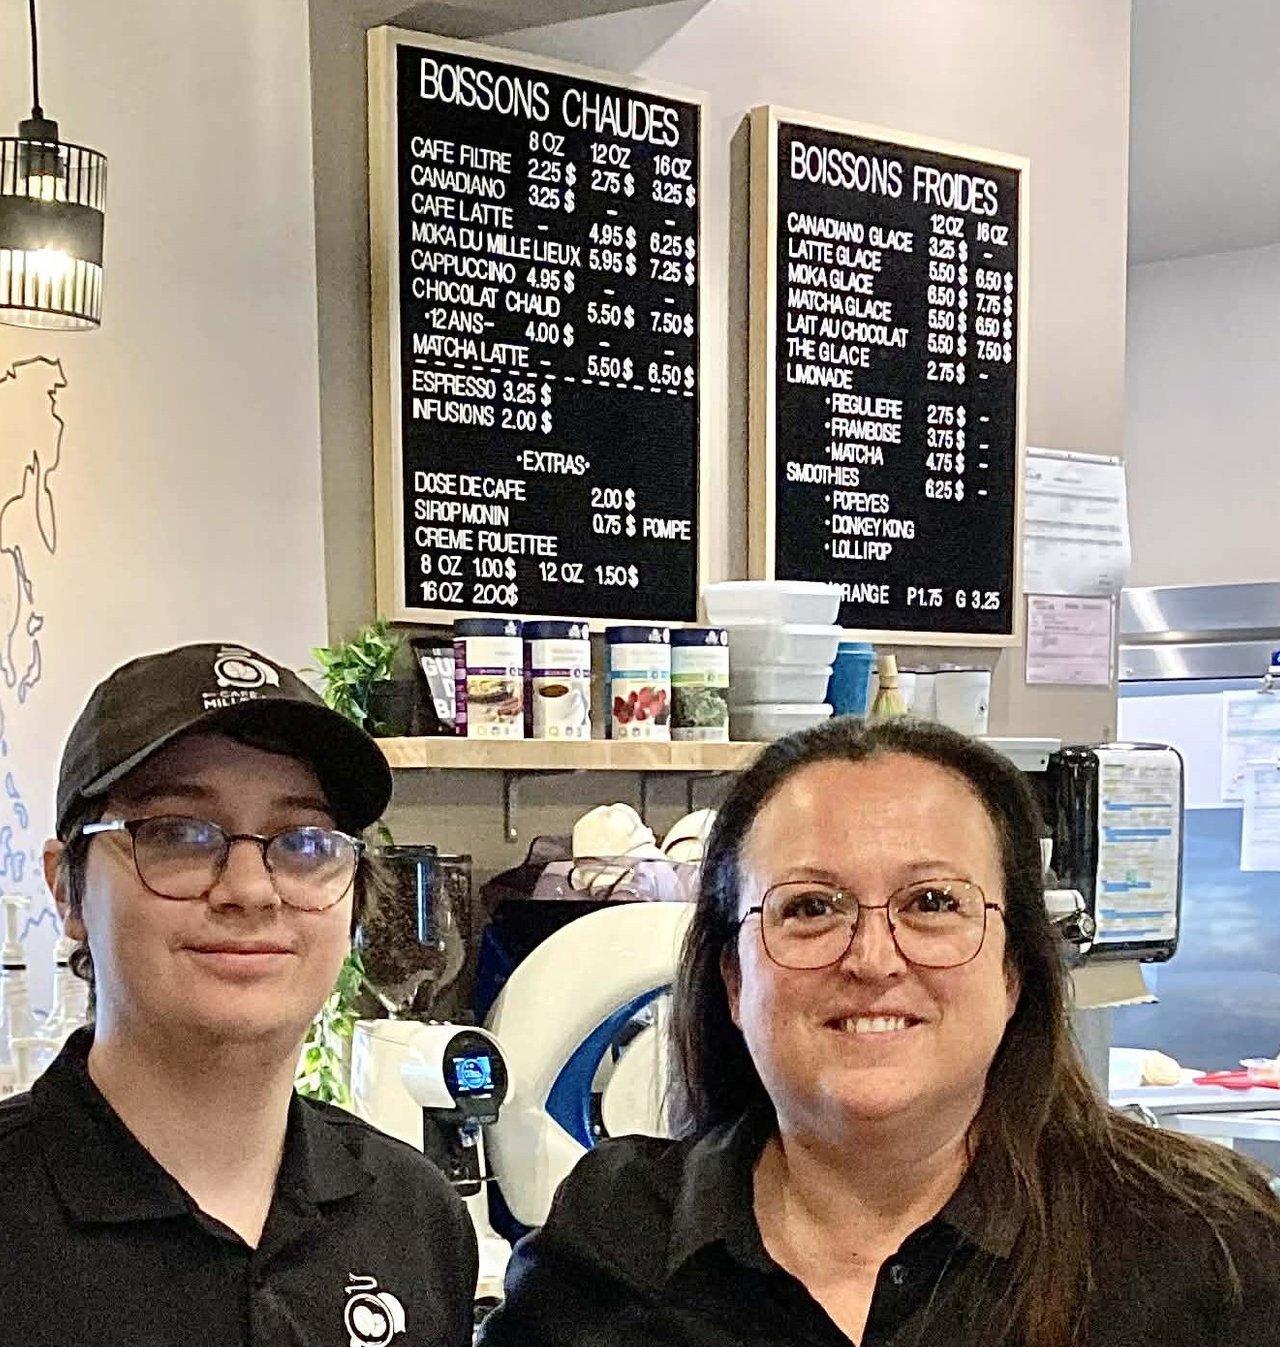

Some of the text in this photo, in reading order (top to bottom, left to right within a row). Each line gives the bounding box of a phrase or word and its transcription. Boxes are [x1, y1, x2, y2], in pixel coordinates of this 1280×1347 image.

[420, 57, 680, 148] BOISSONS CHAUDES
[410, 136, 455, 164] CAFE
[459, 143, 512, 174] FILTRE
[410, 164, 506, 200] CANADIANO
[790, 140, 999, 216] BOISSONS FROIDES
[411, 192, 456, 220] CAFE
[459, 199, 514, 230] LATTE
[411, 220, 457, 248] MOKA
[459, 227, 483, 251] DU
[486, 232, 532, 260] MILLE
[533, 239, 582, 268] LIEUX
[787, 211, 865, 244] CANADIANO
[868, 226, 914, 253] GLACE
[411, 249, 517, 284] CAPPUCCINO
[788, 237, 834, 264] LATTE
[835, 245, 882, 272] GLACE
[788, 262, 828, 288] MOKA
[829, 268, 874, 295] GLACE
[412, 276, 500, 309] CHOCOLAT
[505, 289, 560, 318] CHAUD
[788, 287, 844, 315] MATCHA
[844, 295, 892, 323] GLACE
[786, 311, 818, 336] LAIT
[819, 317, 840, 339] AU
[841, 320, 909, 349] CHOCOLAT
[412, 333, 478, 361] MATCHA
[480, 340, 529, 368] LATTE
[786, 337, 816, 361] THE
[818, 341, 870, 368] GLACE
[412, 369, 497, 400] ESPRESSO
[786, 362, 853, 390] LIMONADE
[412, 397, 495, 427] INFUSIONS
[831, 392, 903, 420] REGULIERE
[831, 417, 901, 444] FRAMBOISE
[831, 441, 884, 466] MATCHA
[414, 471, 457, 495] DOSE
[786, 461, 860, 487] SMOOTHIES
[833, 490, 889, 514] POPEYES
[415, 526, 558, 557] CREME FOUETTEE
[642, 517, 692, 541] POMPE
[831, 514, 915, 539] DONKEY KONG
[420, 553, 432, 575] 8
[437, 554, 463, 576] OZ
[831, 538, 893, 561] LOLLIPOP
